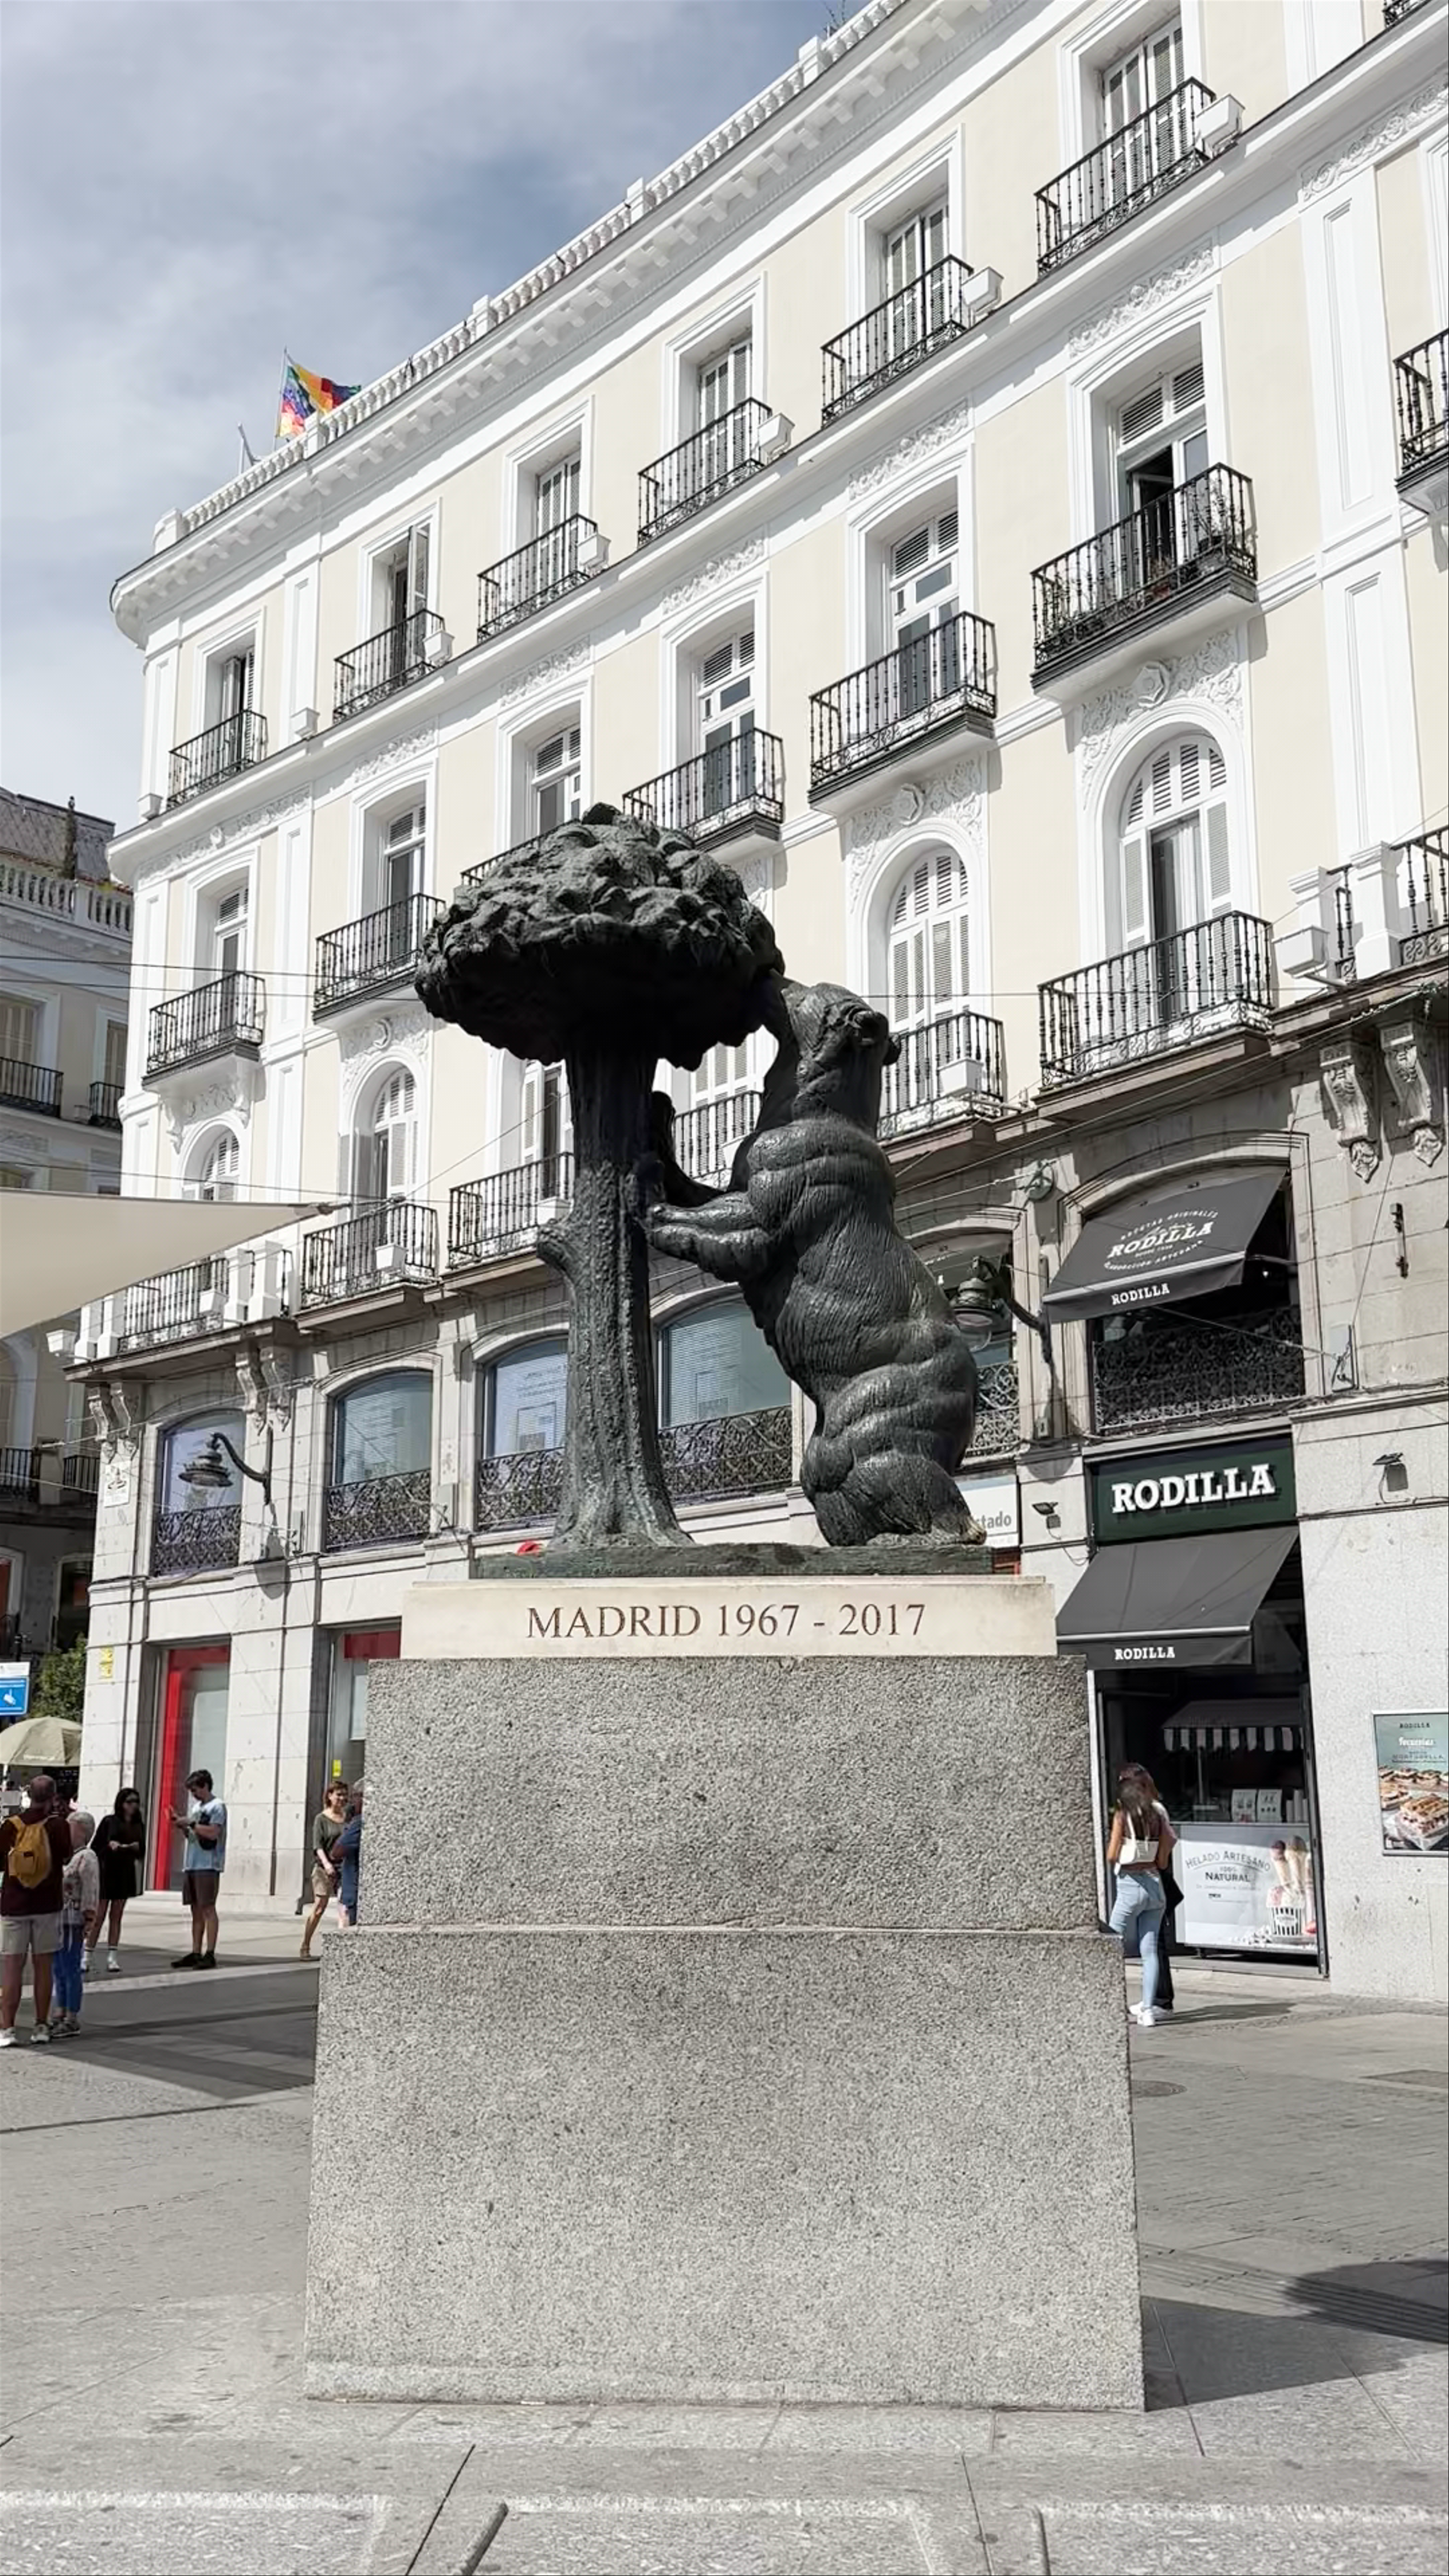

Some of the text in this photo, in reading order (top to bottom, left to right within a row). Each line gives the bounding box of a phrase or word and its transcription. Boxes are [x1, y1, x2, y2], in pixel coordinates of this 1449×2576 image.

[1106, 1221, 1214, 1259] RODILLA
[1111, 1283, 1170, 1306] RODILLA
[1111, 1464, 1275, 1513] RODILLA
[977, 1510, 1012, 1529] tado
[526, 1604, 701, 1638] MADRID
[718, 1604, 800, 1636] 1967
[838, 1603, 926, 1636] 2017
[1115, 1646, 1175, 1660] RODILLA
[1185, 1850, 1271, 1872] HELADO ARTESANO
[1205, 1872, 1251, 1882] NATURAL
